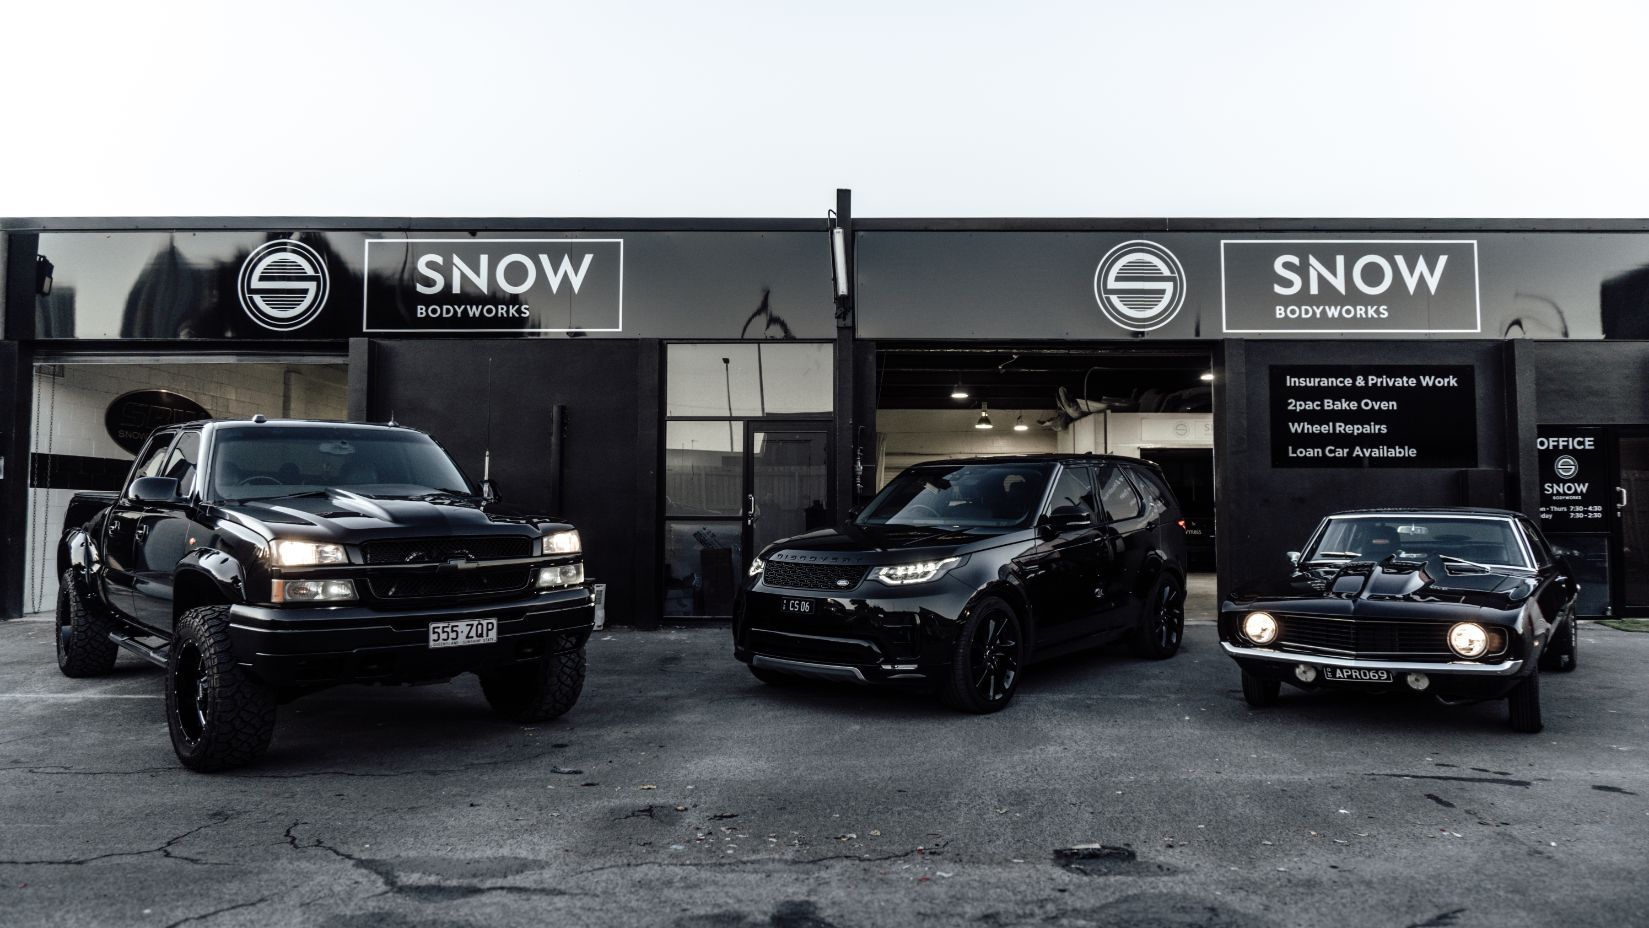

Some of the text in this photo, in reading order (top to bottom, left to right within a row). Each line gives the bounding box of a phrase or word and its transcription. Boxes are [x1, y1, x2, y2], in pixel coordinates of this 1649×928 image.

[416, 253, 594, 295] SNOW
[1273, 254, 1449, 296] SNOW
[416, 304, 530, 318] BODYWORKS
[1275, 305, 1389, 319] BODYWORKS
[1286, 375, 1458, 388] Insurance & Private Work
[1287, 398, 1398, 413] 2pac Bake Oven
[1288, 421, 1388, 437] Wheel Repairs
[1536, 437, 1595, 450] OFFICE
[1288, 445, 1418, 458] Loan Car Available
[1544, 482, 1589, 494] SNOW
[789, 600, 800, 611] CS
